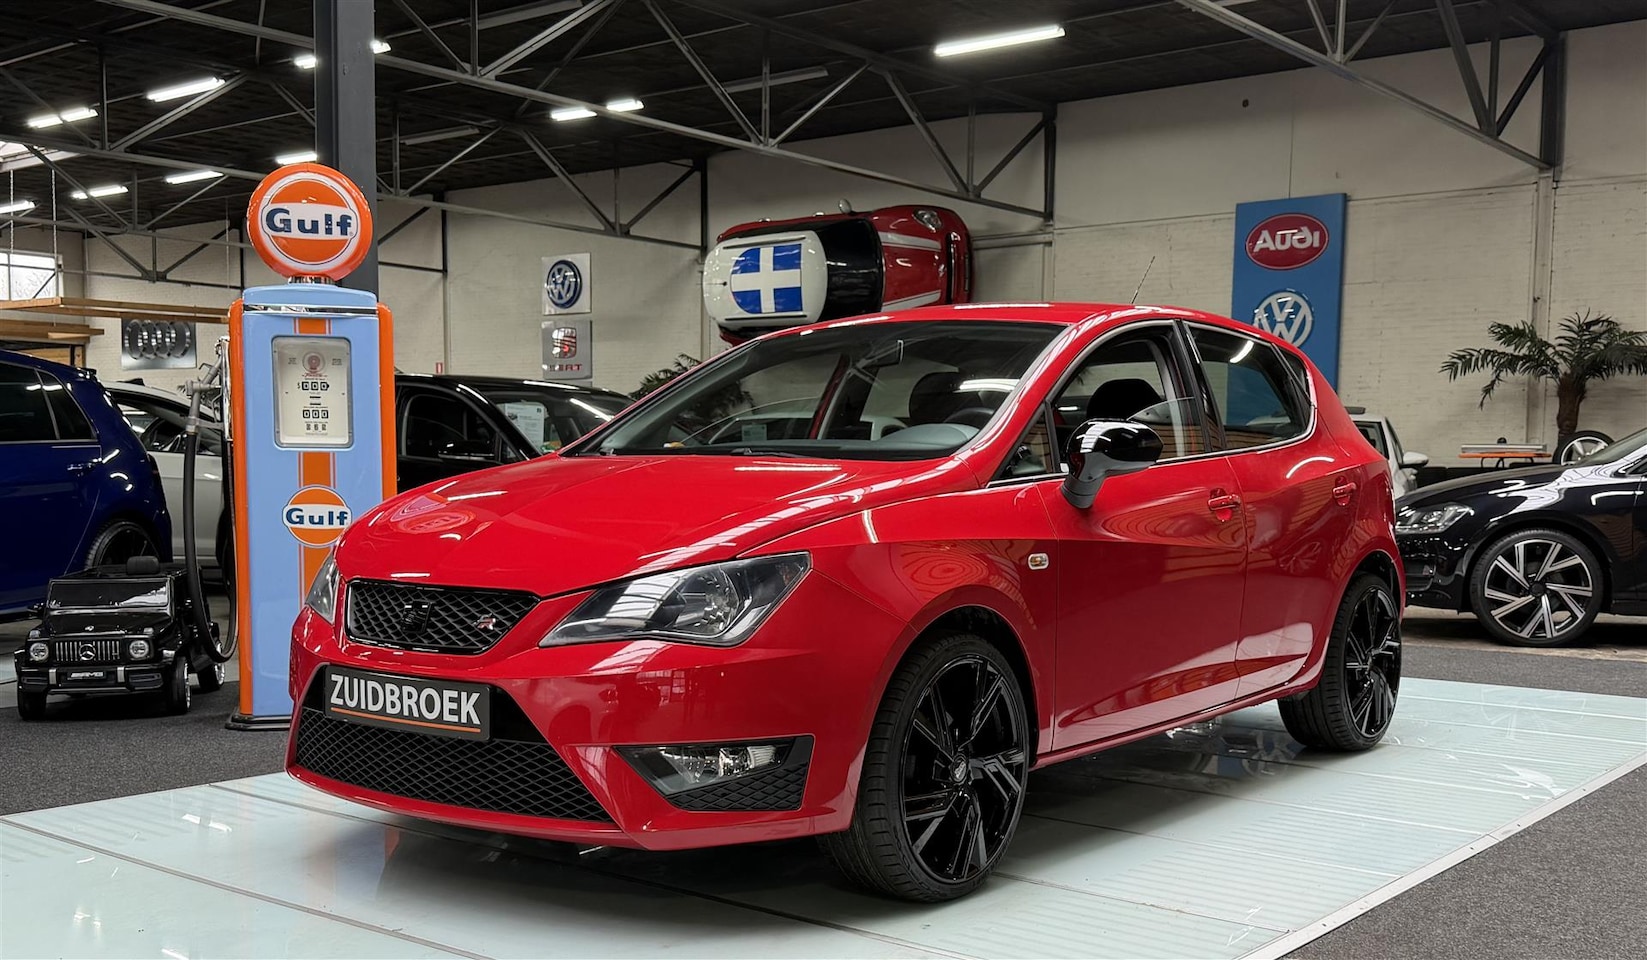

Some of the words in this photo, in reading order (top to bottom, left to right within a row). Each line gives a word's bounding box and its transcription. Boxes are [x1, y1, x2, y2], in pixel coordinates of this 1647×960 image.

[265, 207, 352, 236] Gulf
[1253, 226, 1320, 253] Audi
[286, 507, 348, 526] Gulf
[330, 673, 481, 725] ZUIDBROEK
